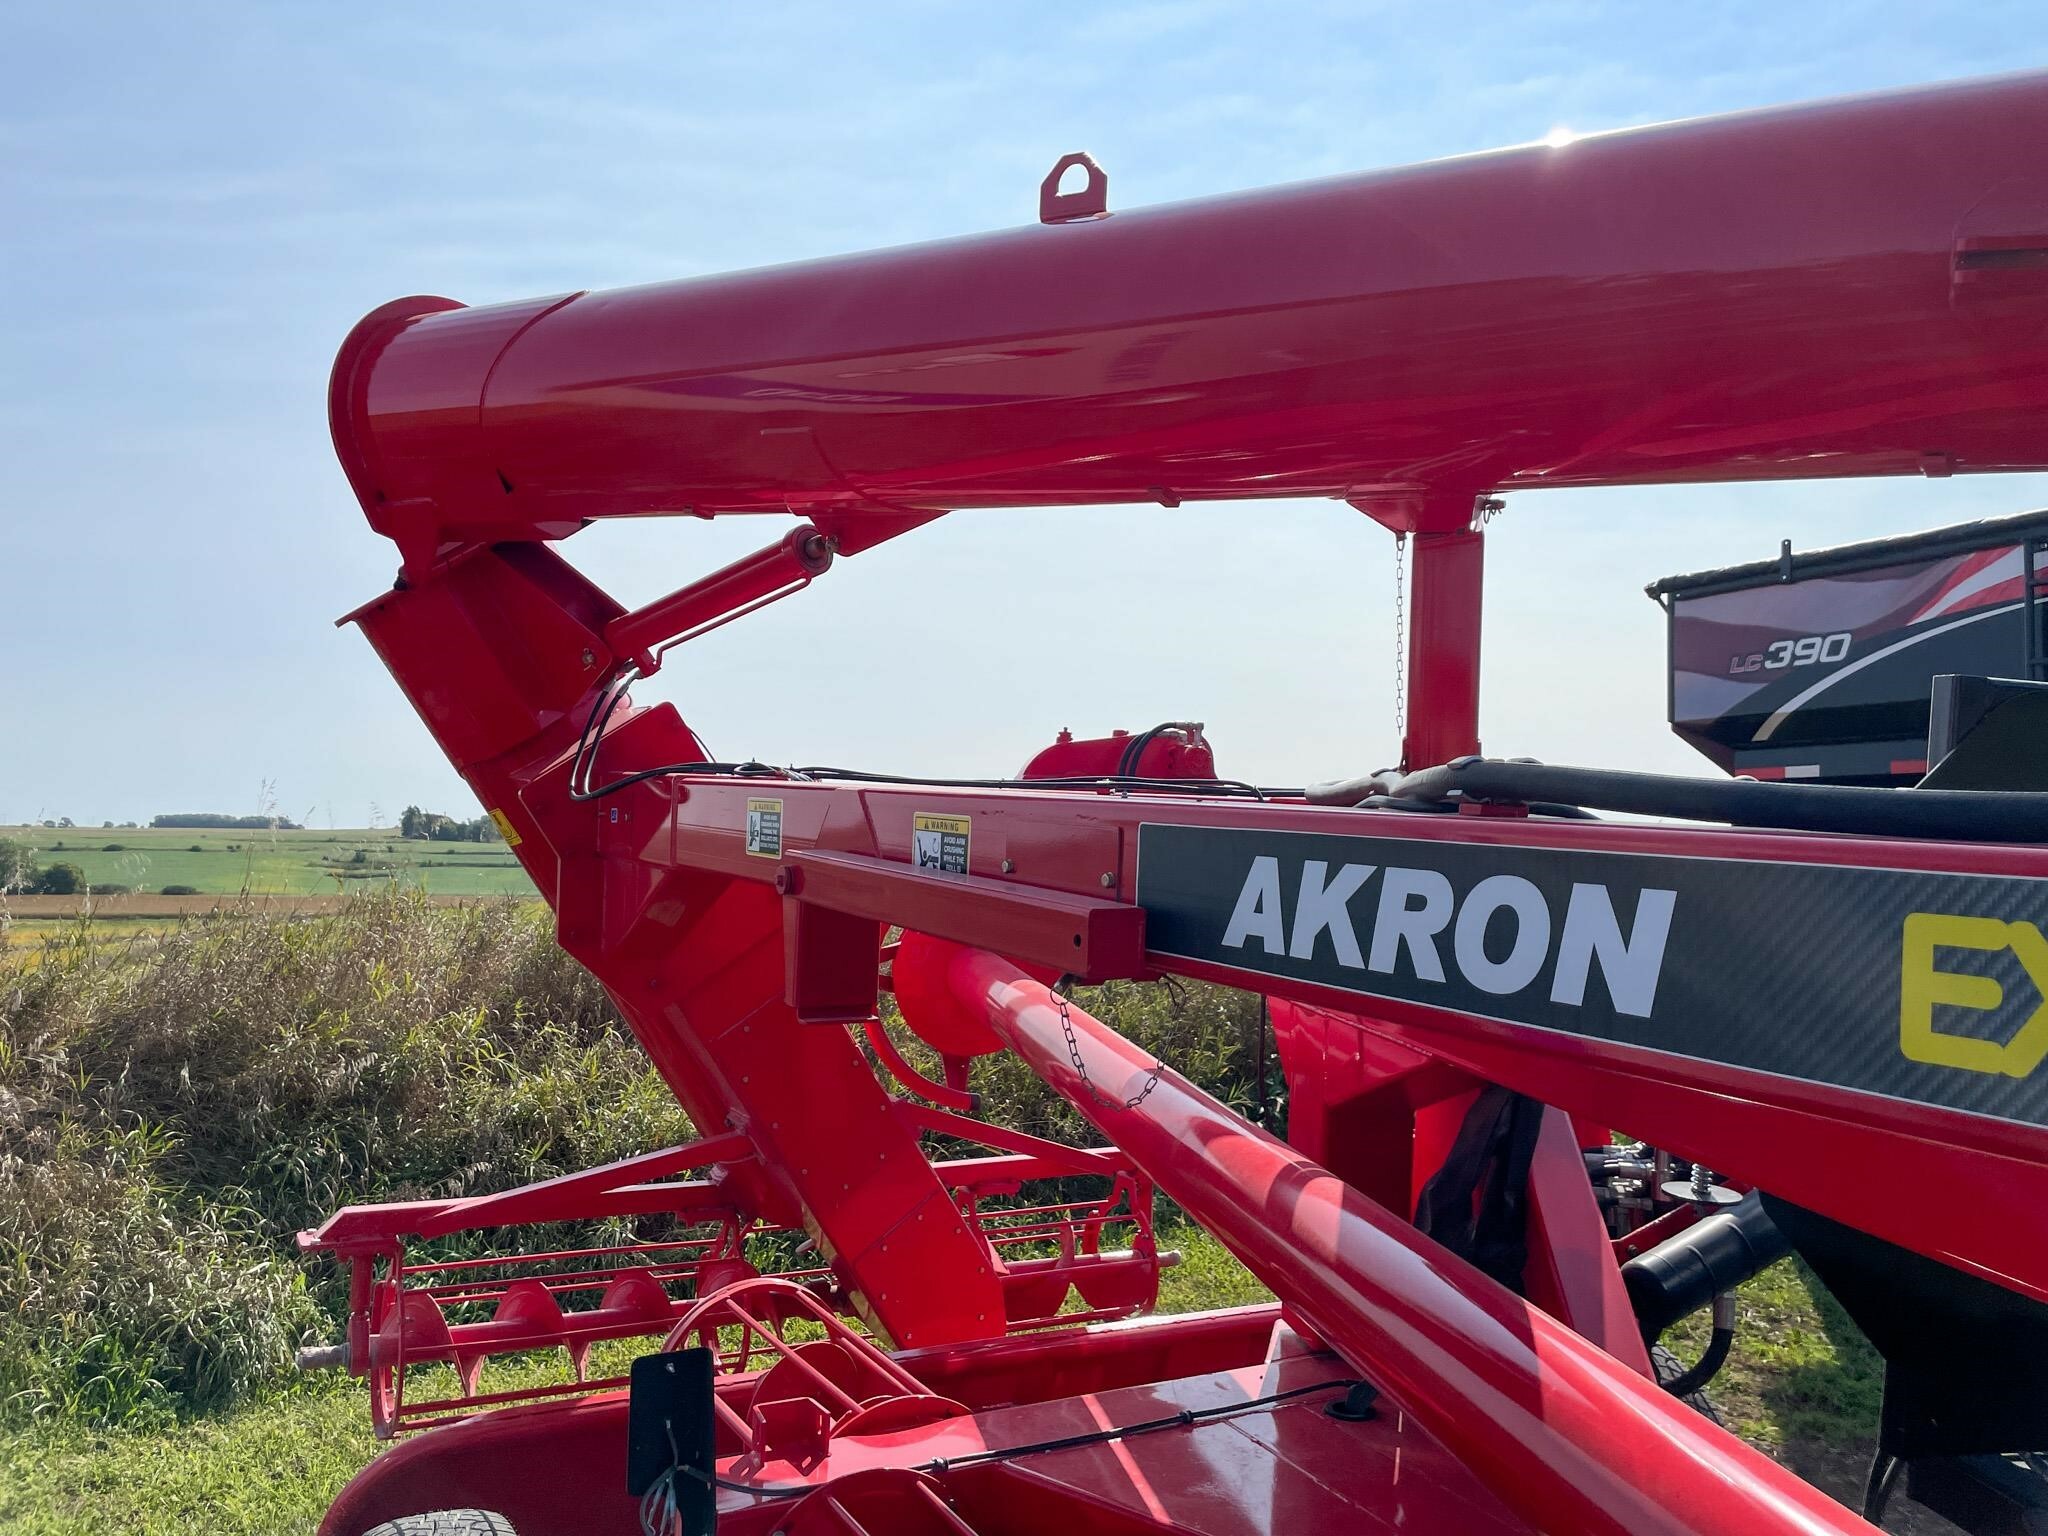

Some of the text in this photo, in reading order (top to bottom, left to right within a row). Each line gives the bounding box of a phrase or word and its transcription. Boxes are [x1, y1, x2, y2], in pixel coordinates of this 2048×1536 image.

[930, 820, 959, 832] WARNING
[943, 836, 956, 844] AVOID
[1221, 856, 1677, 1018] AKRON
